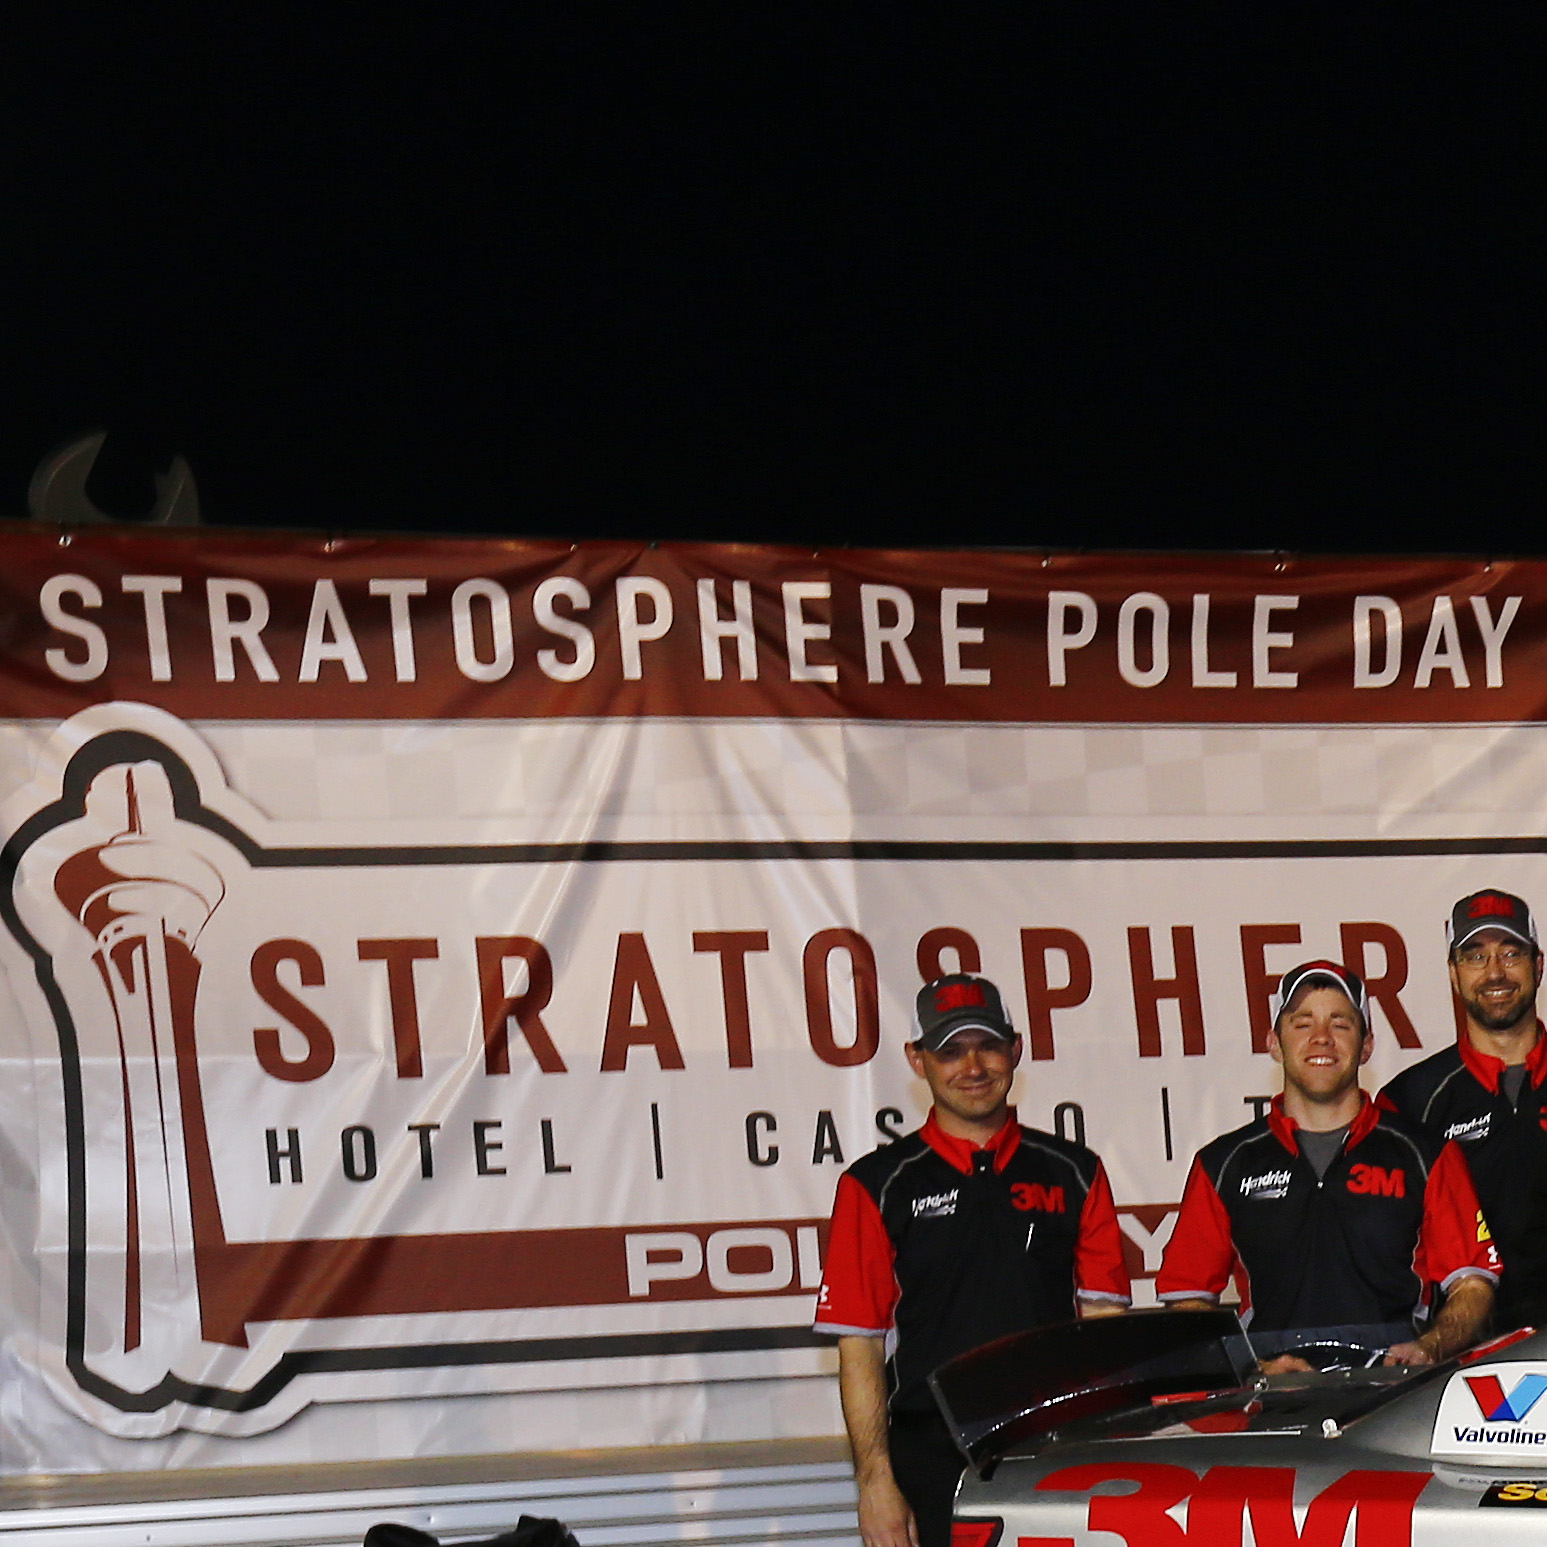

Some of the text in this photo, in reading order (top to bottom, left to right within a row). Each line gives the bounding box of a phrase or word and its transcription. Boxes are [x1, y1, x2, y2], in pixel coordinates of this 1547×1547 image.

[40, 574, 1522, 689] STRATOSPHERE POLE DAY
[1468, 894, 1514, 918] 3M
[250, 920, 1470, 1083] STRATOPHER
[266, 1119, 572, 1185] HOTEL
[1010, 1182, 1066, 1214] 3M
[1241, 1169, 1292, 1195] Hendrick
[1346, 1164, 1405, 1198] 3M
[625, 1227, 823, 1297] POL
[1454, 1426, 1546, 1445] Valvoline
